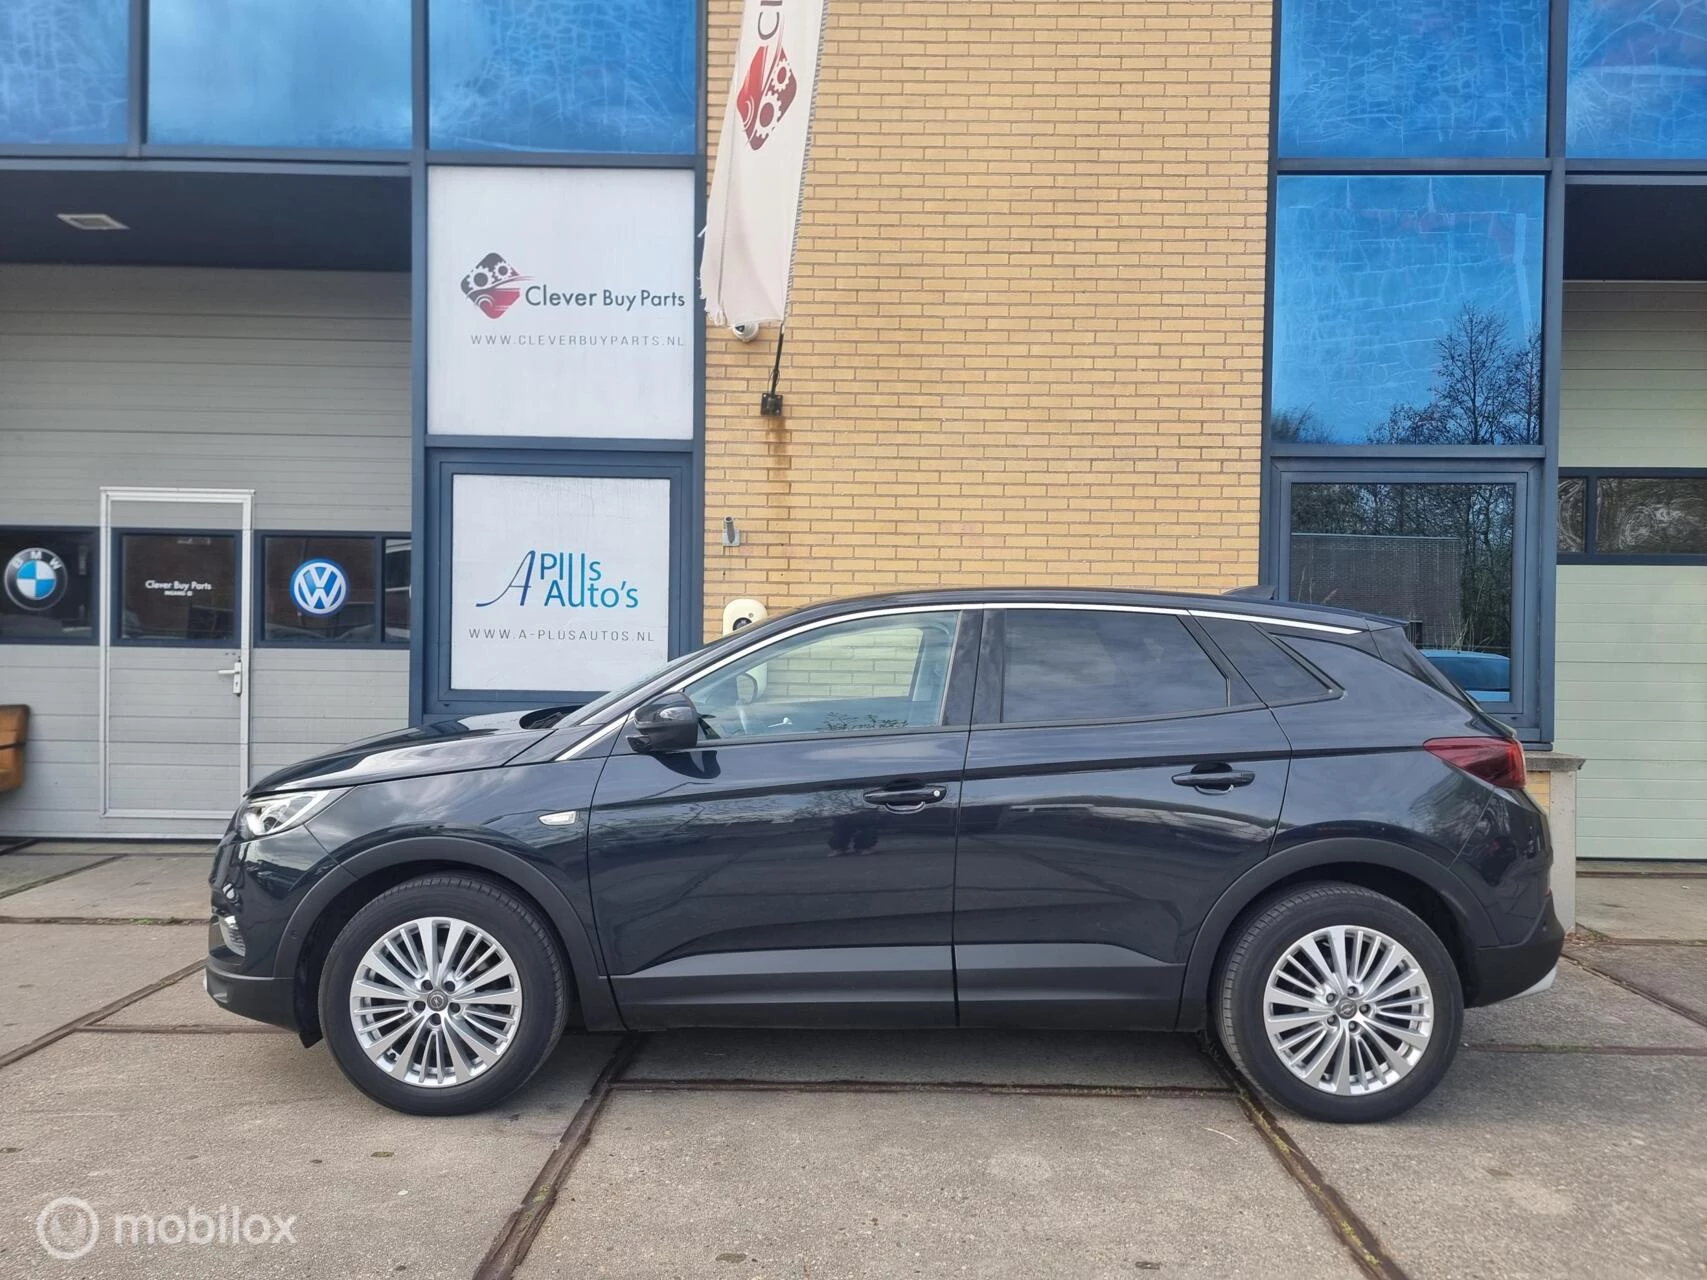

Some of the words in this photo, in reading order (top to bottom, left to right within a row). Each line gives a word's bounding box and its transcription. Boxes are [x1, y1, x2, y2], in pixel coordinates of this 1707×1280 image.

[525, 284, 597, 307] Clever
[603, 289, 636, 311] Buy
[640, 290, 685, 307] Parts
[470, 334, 685, 347] WWW.CLEVERBUYPARTS.NL
[12, 550, 62, 570] BMW
[145, 580, 172, 589] Clever
[173, 581, 189, 591] Buy
[191, 581, 212, 590] Parts
[475, 550, 536, 607] A
[468, 628, 655, 642] WWW.A-PLUSAUTOS.NL
